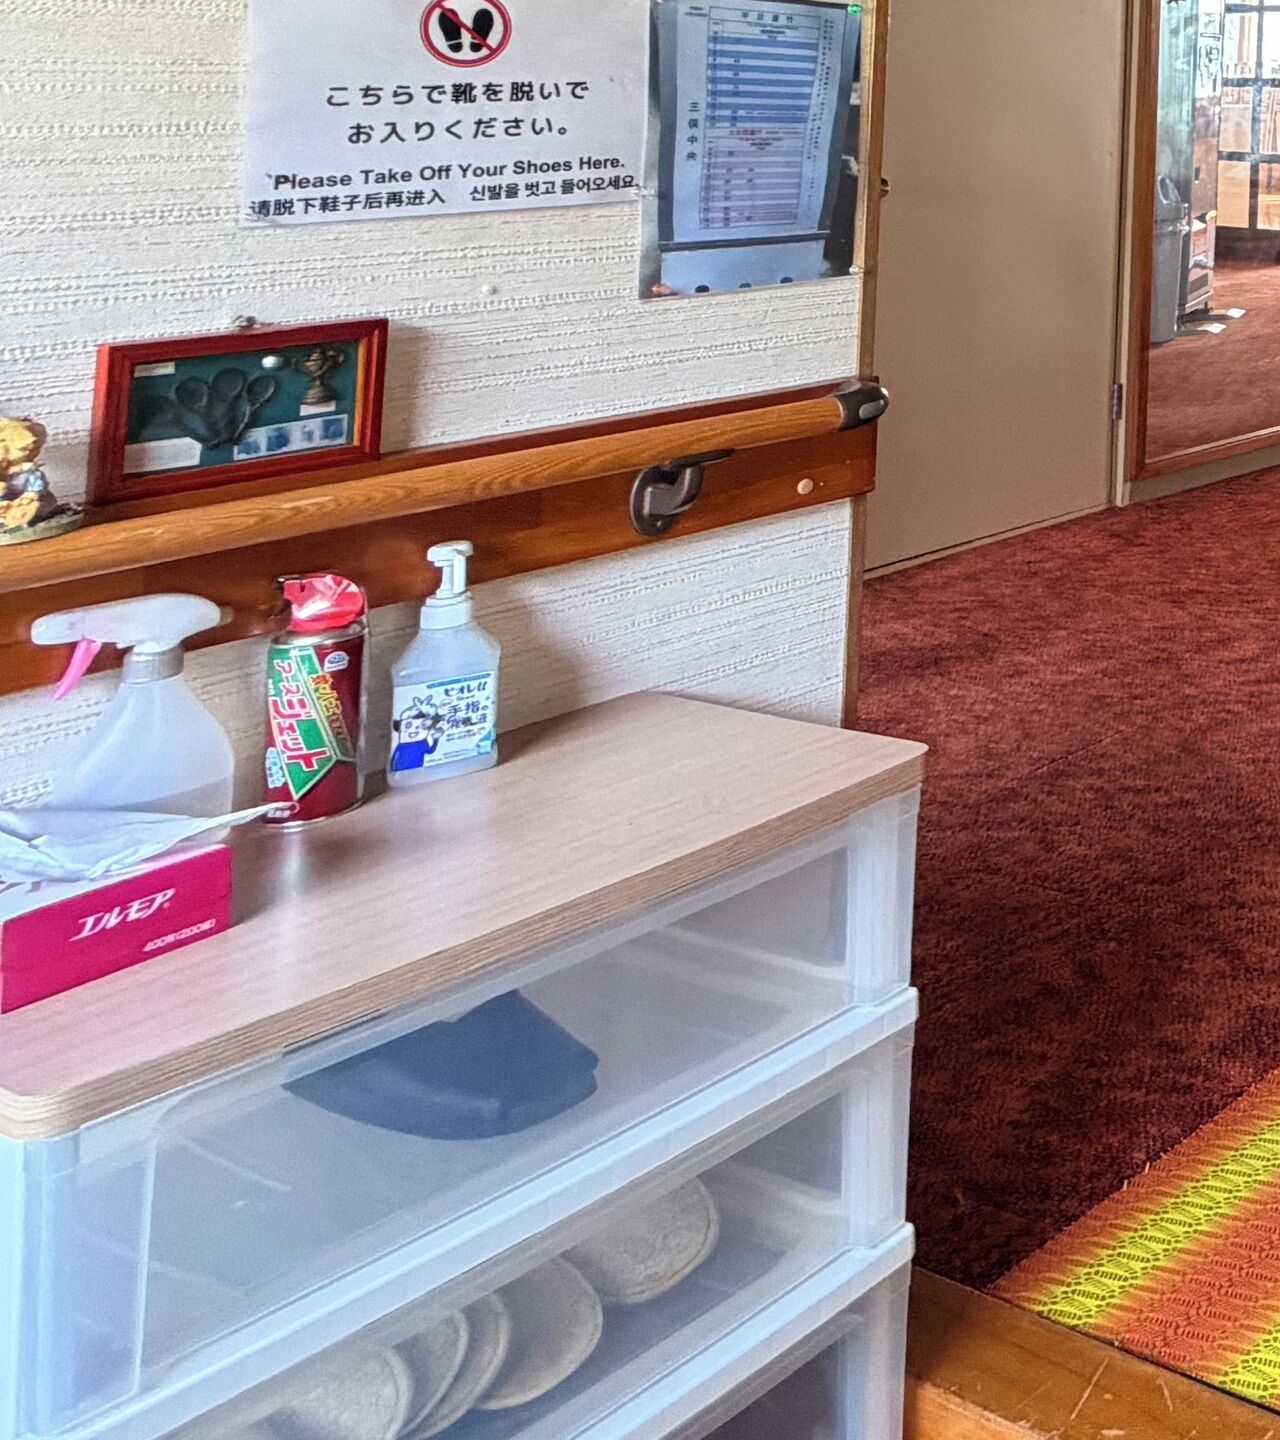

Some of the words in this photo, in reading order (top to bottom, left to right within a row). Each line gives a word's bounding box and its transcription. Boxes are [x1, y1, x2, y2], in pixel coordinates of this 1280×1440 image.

[325, 80, 591, 107] こちらで靴を脱いで
[346, 117, 570, 145] お入りください。
[273, 173, 353, 191] Please
[360, 168, 412, 186] Take
[420, 163, 451, 182] Off
[457, 162, 508, 179] Your
[513, 156, 573, 175] Shoes
[579, 155, 625, 171] Here.
[469, 182, 521, 202] 신발을
[524, 179, 557, 198] 벗고
[560, 174, 640, 195] 들어오세요.
[249, 189, 446, 218] 请脱下鞋子后再进入
[68, 887, 176, 943] エルモア
